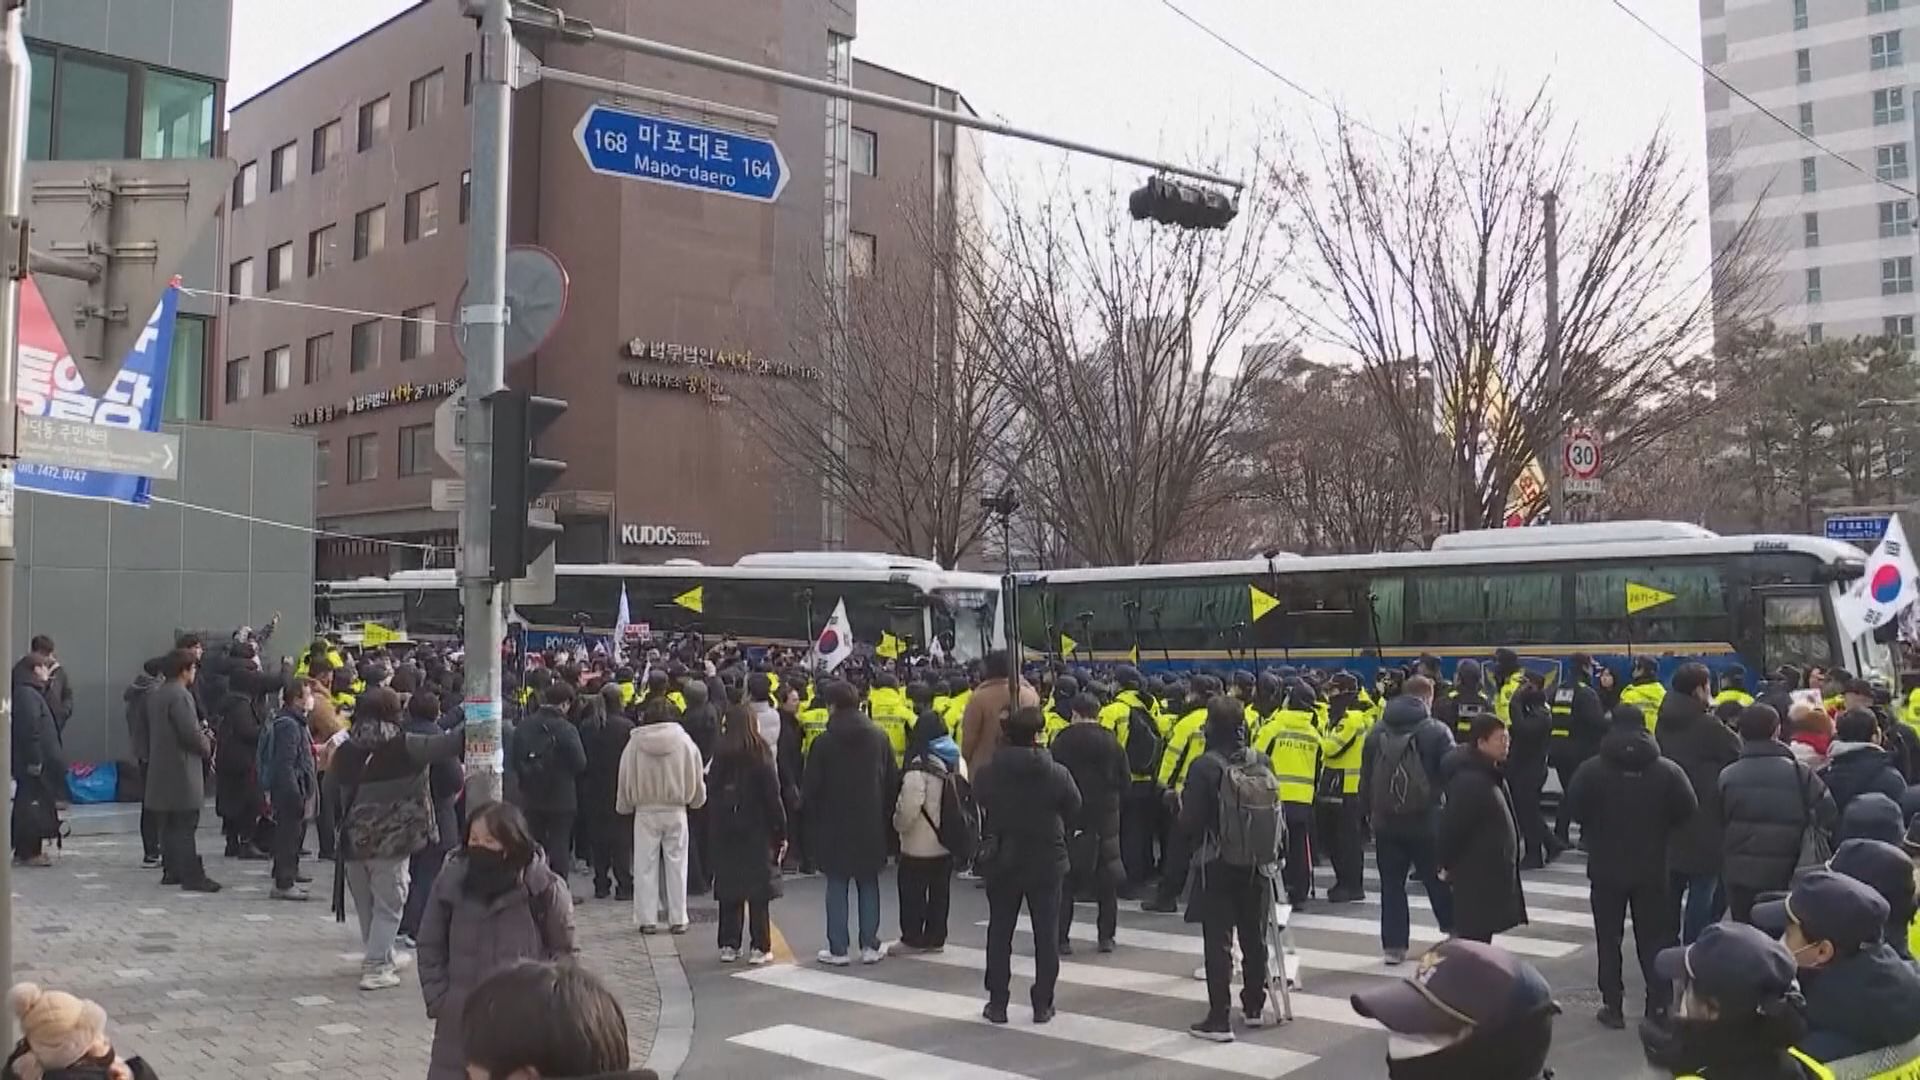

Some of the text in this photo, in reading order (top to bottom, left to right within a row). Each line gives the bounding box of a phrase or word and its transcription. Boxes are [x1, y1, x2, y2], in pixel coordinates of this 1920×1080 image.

[594, 129, 628, 153] 168
[638, 124, 733, 162] 마포대로
[634, 153, 736, 187] Mapo-daero
[742, 157, 772, 181] 164
[649, 341, 714, 366] 법무법인
[23, 417, 55, 440] 덕동
[1573, 446, 1593, 465] 30
[622, 524, 677, 545] KUDOS
